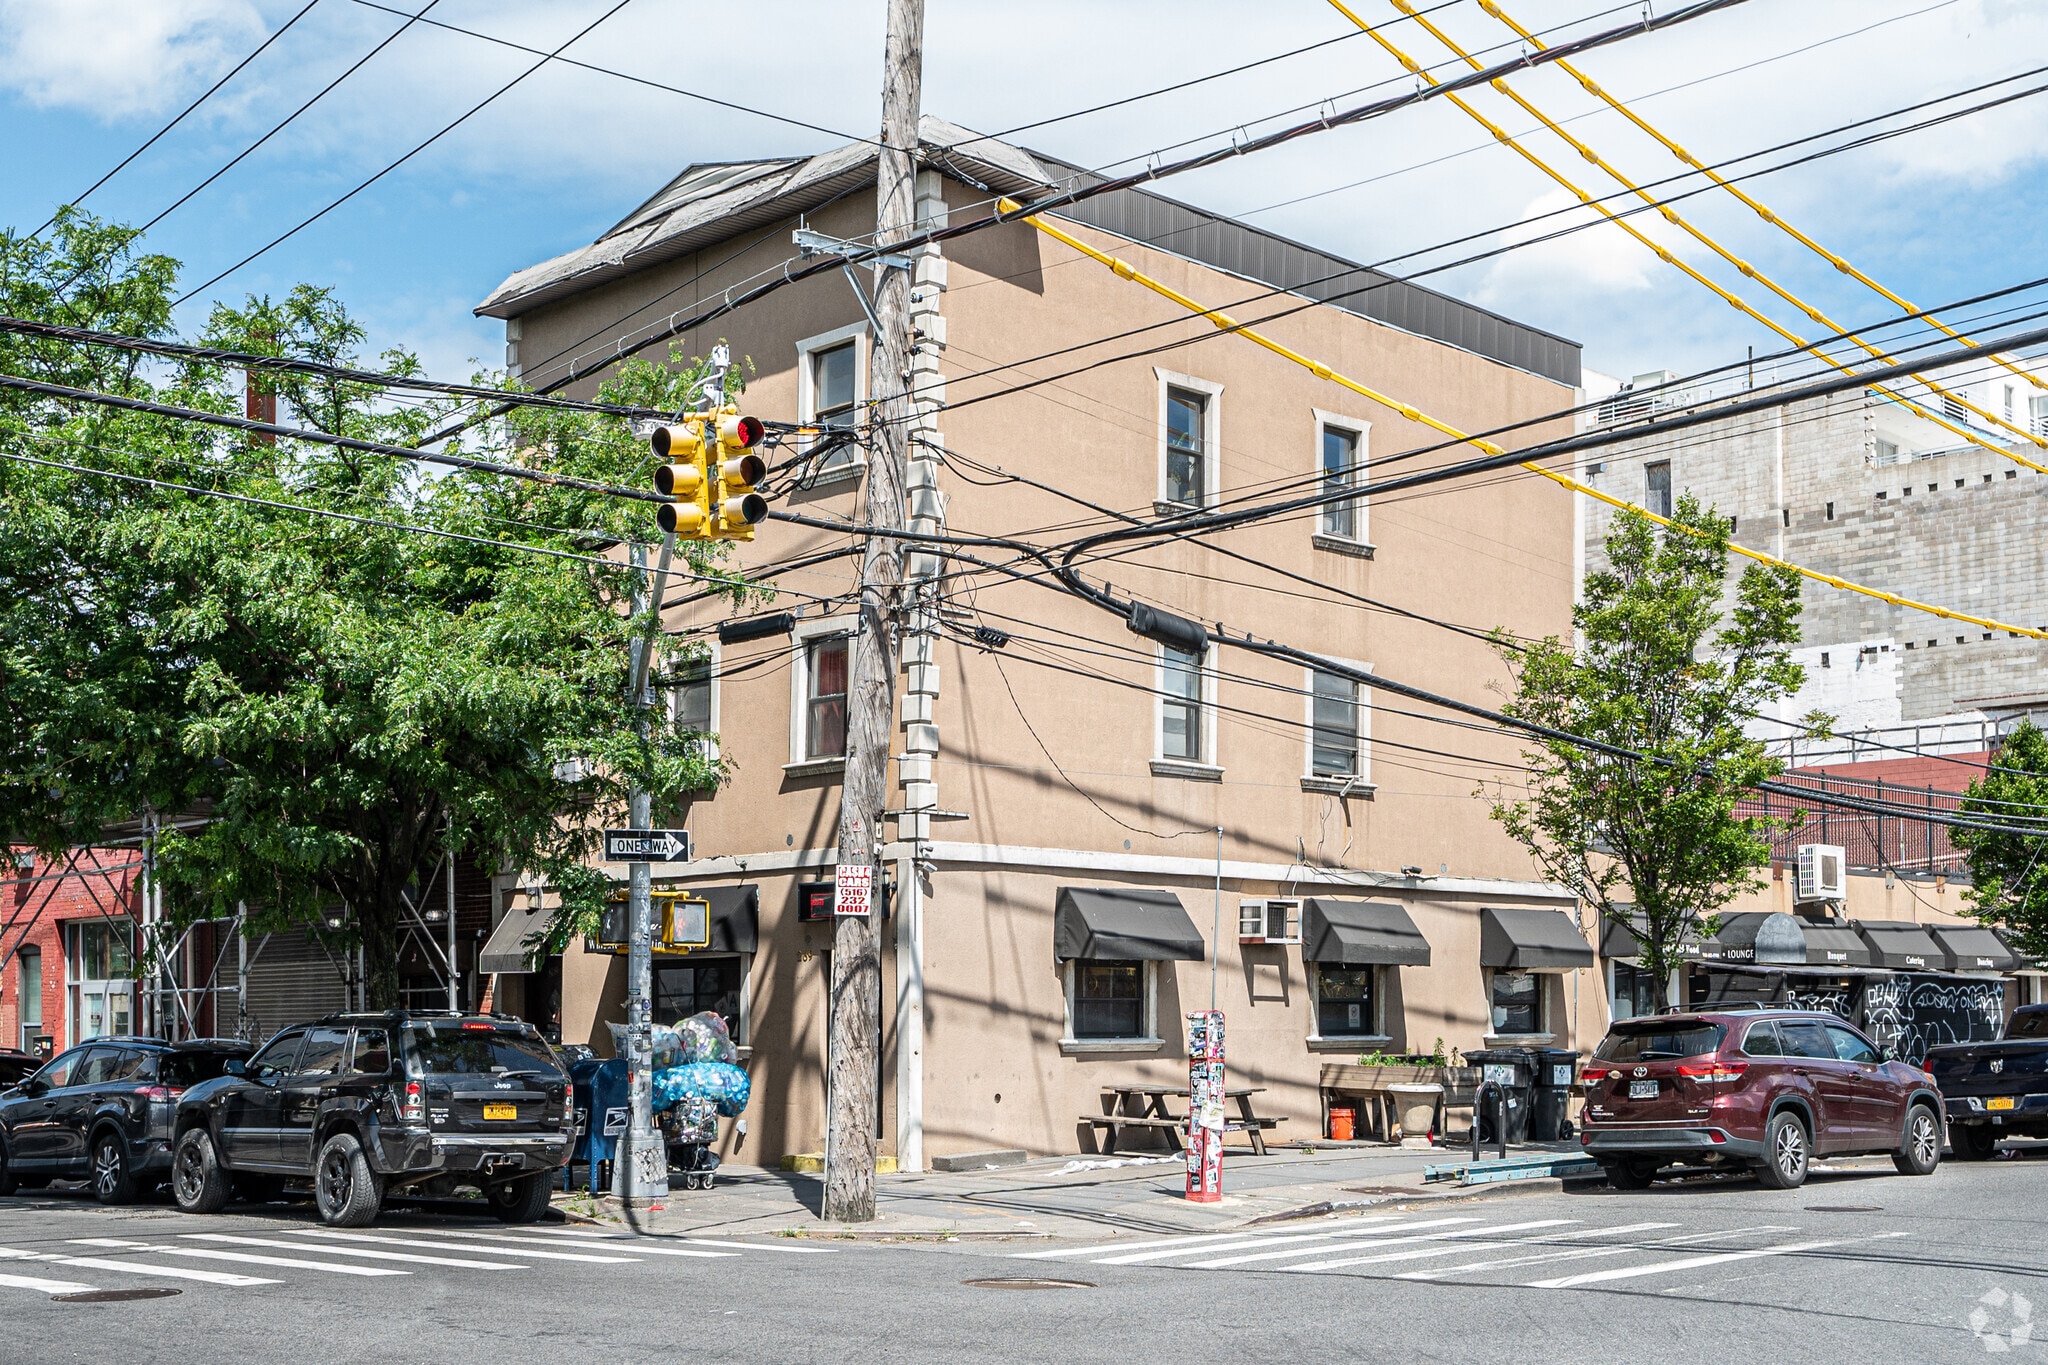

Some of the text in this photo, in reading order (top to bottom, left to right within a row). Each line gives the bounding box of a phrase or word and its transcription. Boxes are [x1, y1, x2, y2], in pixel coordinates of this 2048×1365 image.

[617, 840, 678, 853] ONE WAY
[838, 866, 864, 877] CASH
[838, 877, 870, 887] CARS
[840, 888, 868, 897] (516)
[841, 896, 866, 905] 232
[837, 904, 869, 913] 0007
[1727, 949, 1754, 959] LOUNGE
[1905, 956, 1925, 967] Catering
